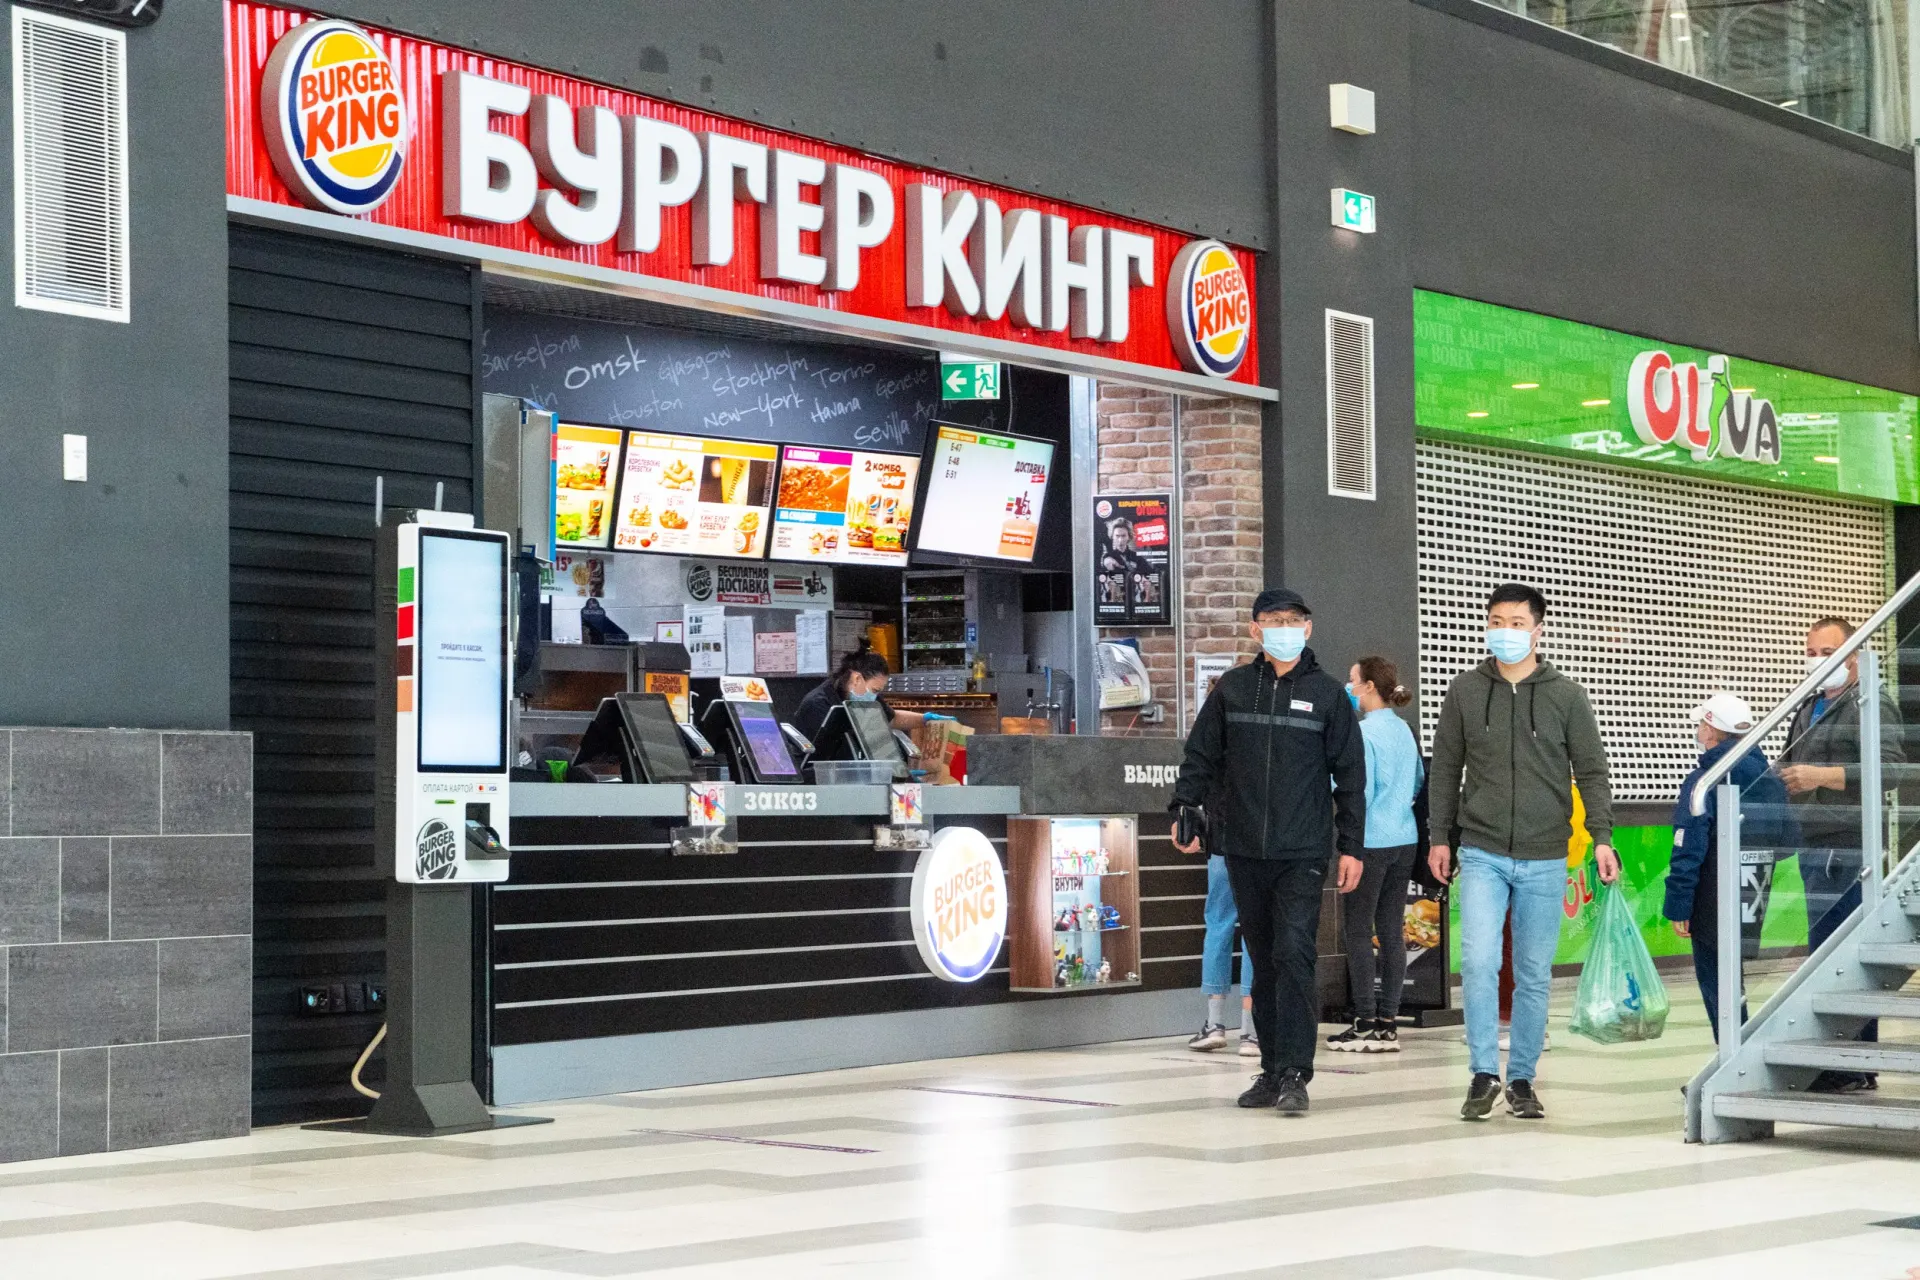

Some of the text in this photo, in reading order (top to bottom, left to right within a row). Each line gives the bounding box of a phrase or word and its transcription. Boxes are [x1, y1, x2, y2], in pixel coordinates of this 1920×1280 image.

[301, 60, 394, 106] BURGER
[303, 93, 399, 160] KING
[443, 70, 1155, 343] БУРГЕР КИНГ
[1194, 267, 1246, 313] BURGER
[1196, 291, 1248, 342] KING
[564, 335, 647, 390] Omsk
[658, 344, 732, 386] Glasgow
[712, 350, 809, 397] Stockholm
[811, 362, 876, 389] Torino
[608, 390, 684, 425] Houston
[810, 397, 862, 424] Havana
[1627, 350, 1782, 466] OLIVA
[854, 410, 909, 446] Sevilla
[864, 459, 901, 473] 2 КОМБО
[1014, 461, 1046, 475] ДОСТАВКА
[691, 577, 712, 591] KING
[717, 565, 769, 579] БЕСПЛАТНАЯ
[717, 577, 770, 594] ДОСТАВКА
[422, 783, 473, 794] ОПЛАТА КАРТОЙ
[1124, 764, 1180, 787] выда
[744, 791, 818, 811] заказ
[419, 830, 455, 858] BURGER
[420, 843, 456, 877] KING
[934, 859, 993, 914] BURGER
[1054, 876, 1084, 892] ВНУТРИ
[938, 884, 995, 950] KING
